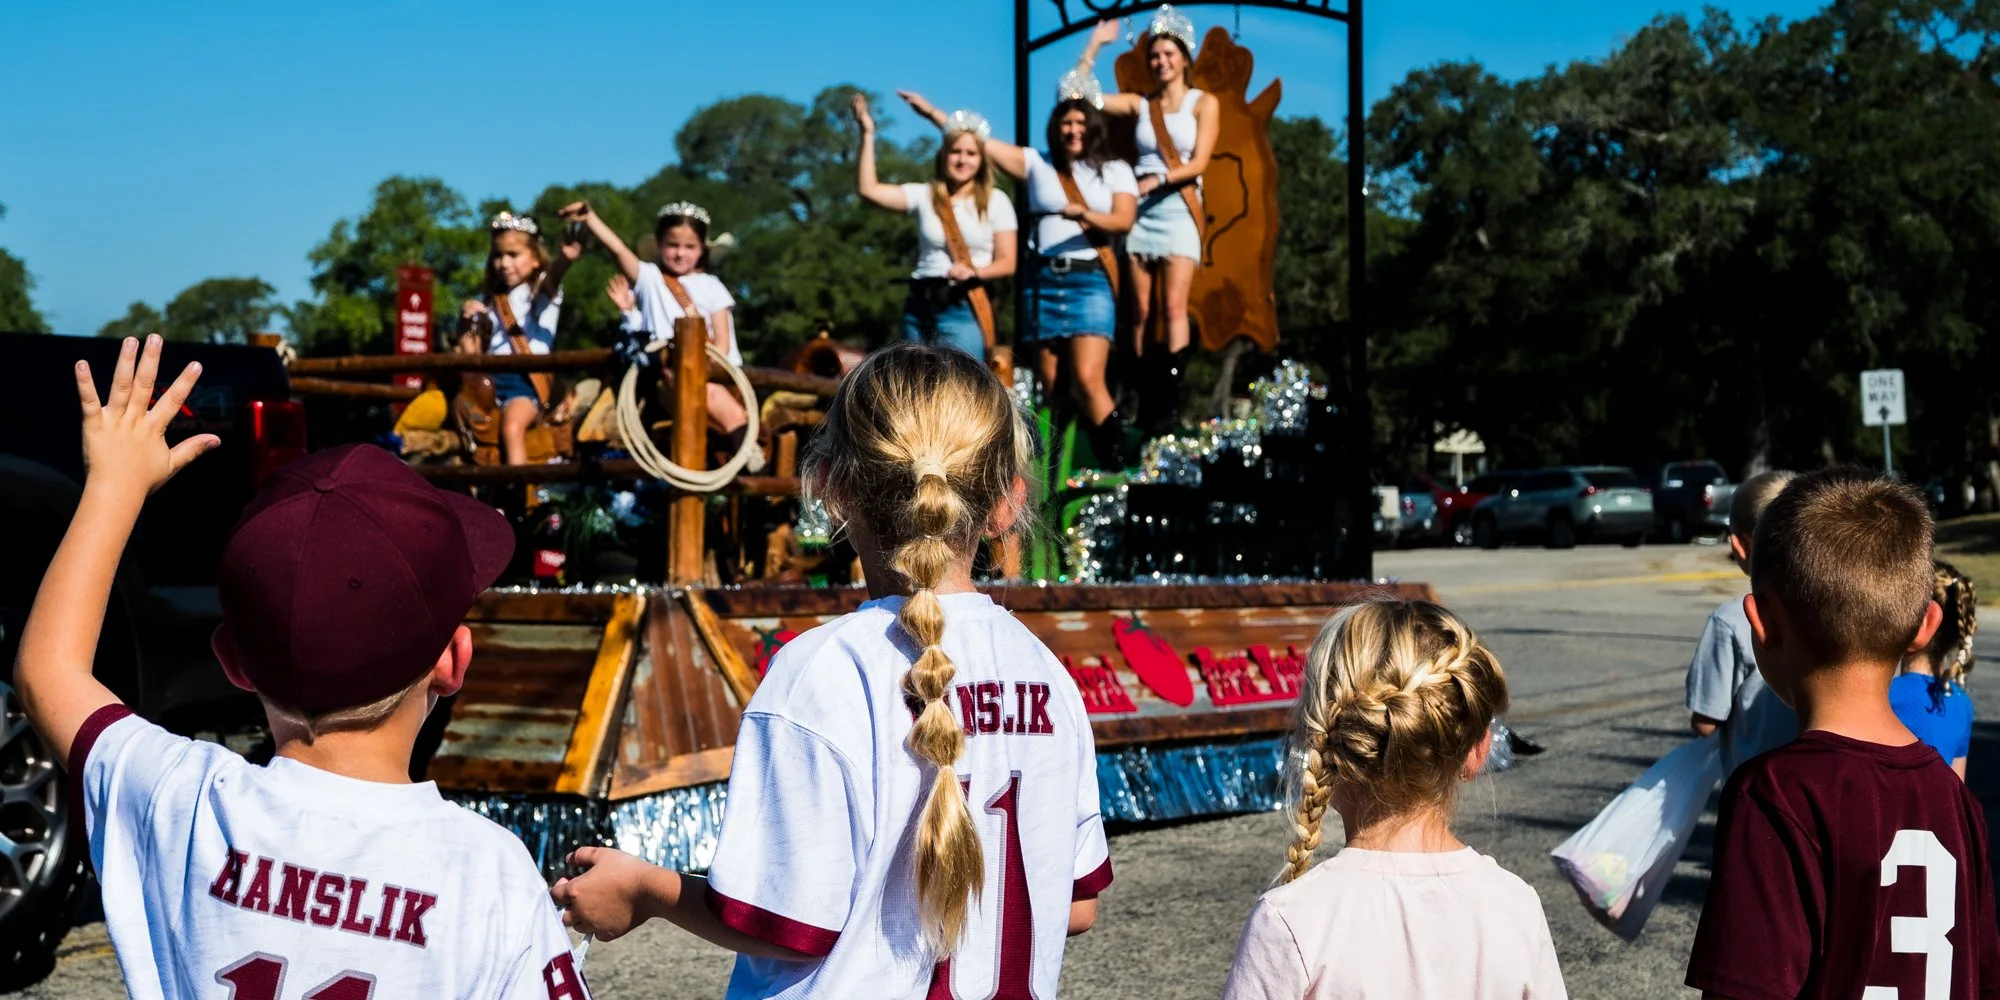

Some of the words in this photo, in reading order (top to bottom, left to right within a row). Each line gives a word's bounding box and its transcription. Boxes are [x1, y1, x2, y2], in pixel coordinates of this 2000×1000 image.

[1868, 374, 1896, 386] ONE
[1868, 390, 1898, 402] WAY
[904, 679, 1055, 738] NSLIK
[208, 846, 438, 948] HANSLIK
[1861, 829, 1957, 1000] 3
